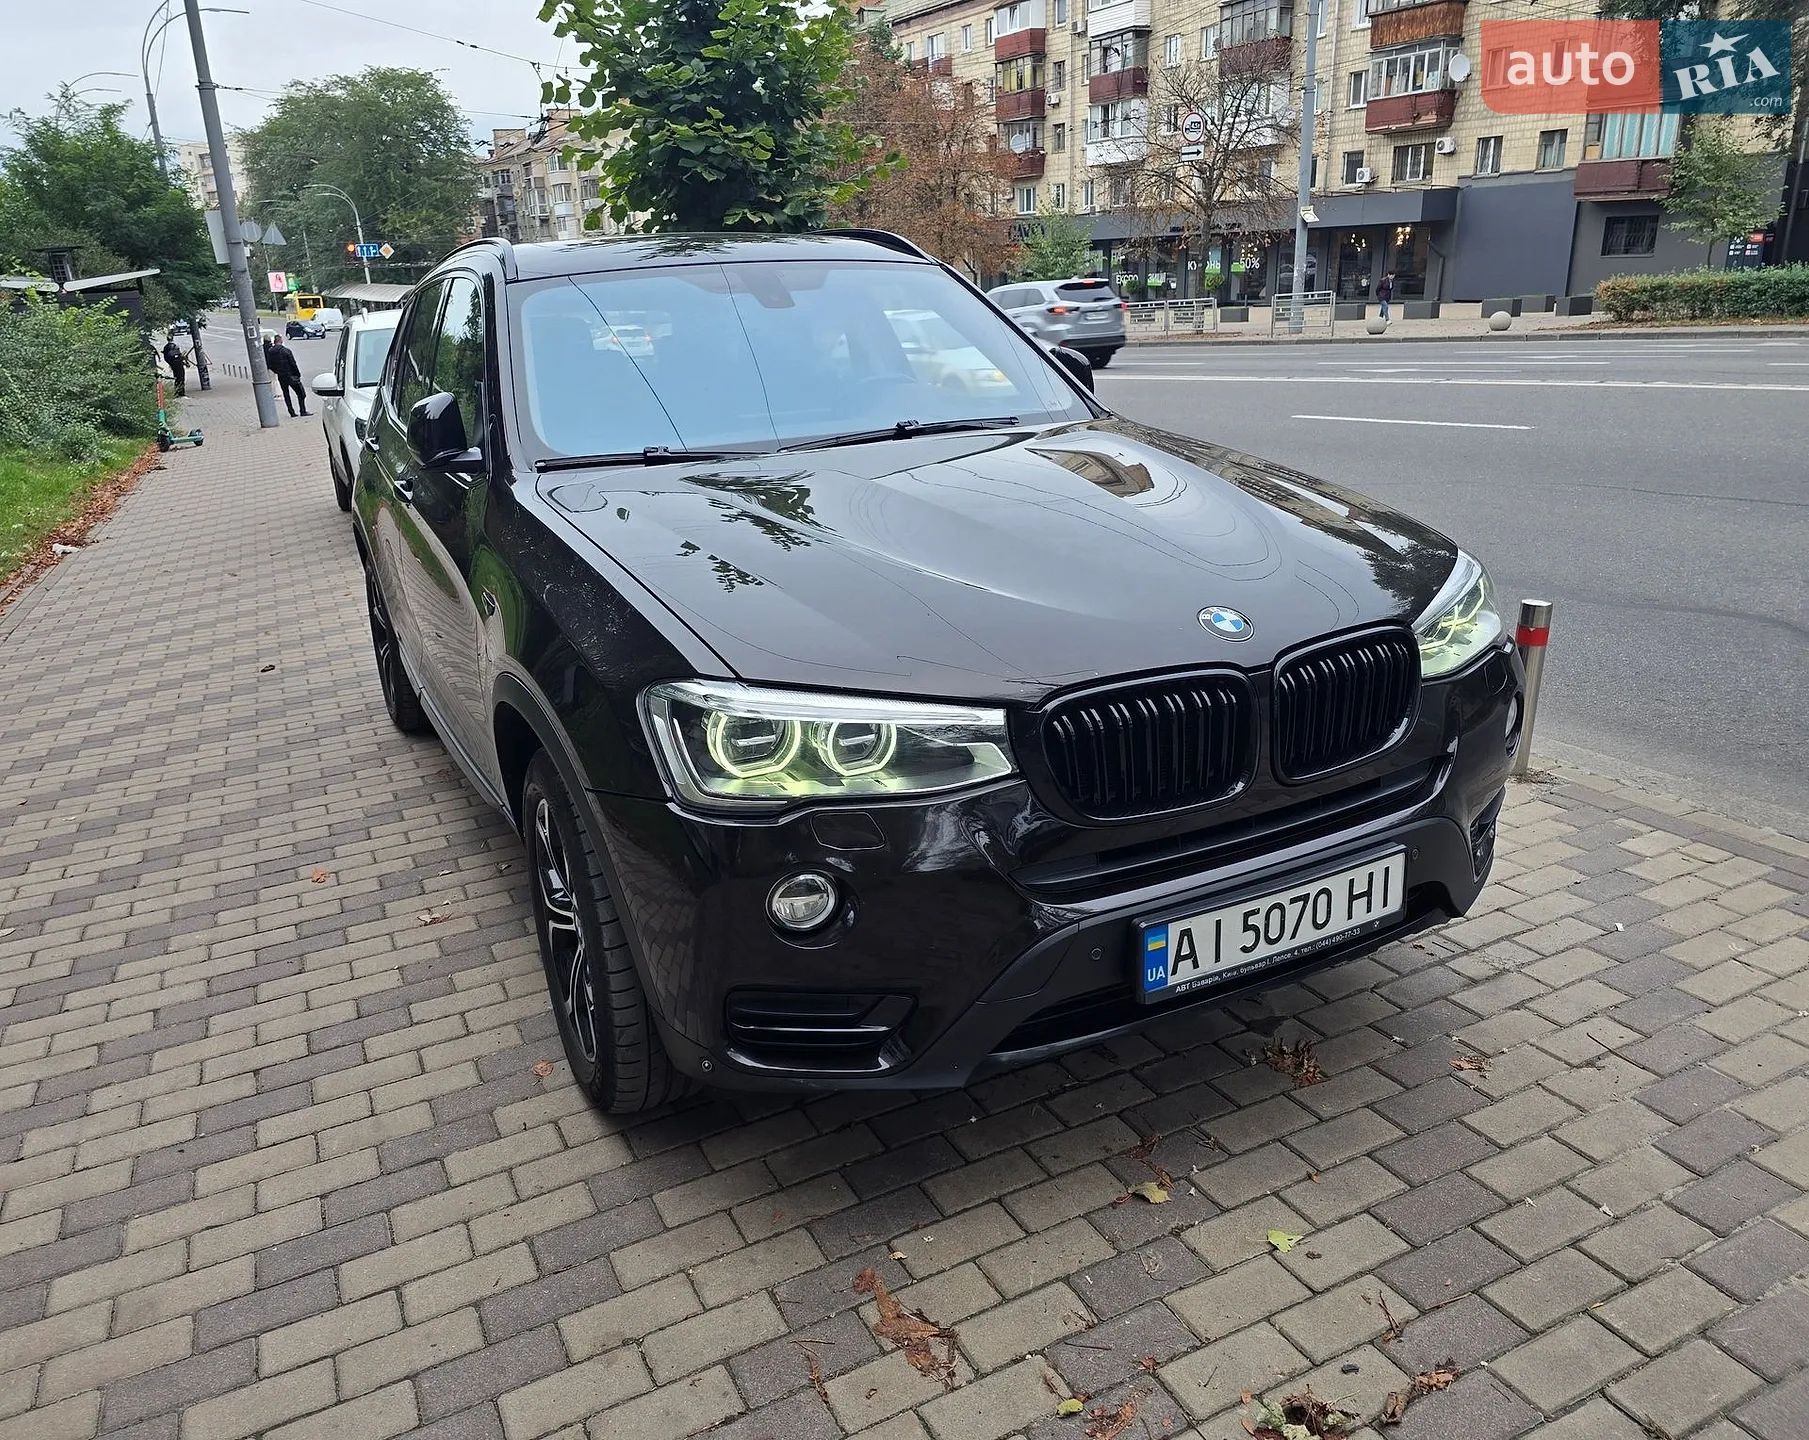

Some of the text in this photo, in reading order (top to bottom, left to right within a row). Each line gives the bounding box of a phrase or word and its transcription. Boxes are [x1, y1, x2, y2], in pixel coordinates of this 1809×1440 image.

[1171, 866, 1390, 976] AI 5070 HI
[1147, 966, 1166, 982] UA
[1175, 983, 1190, 993] АВТ
